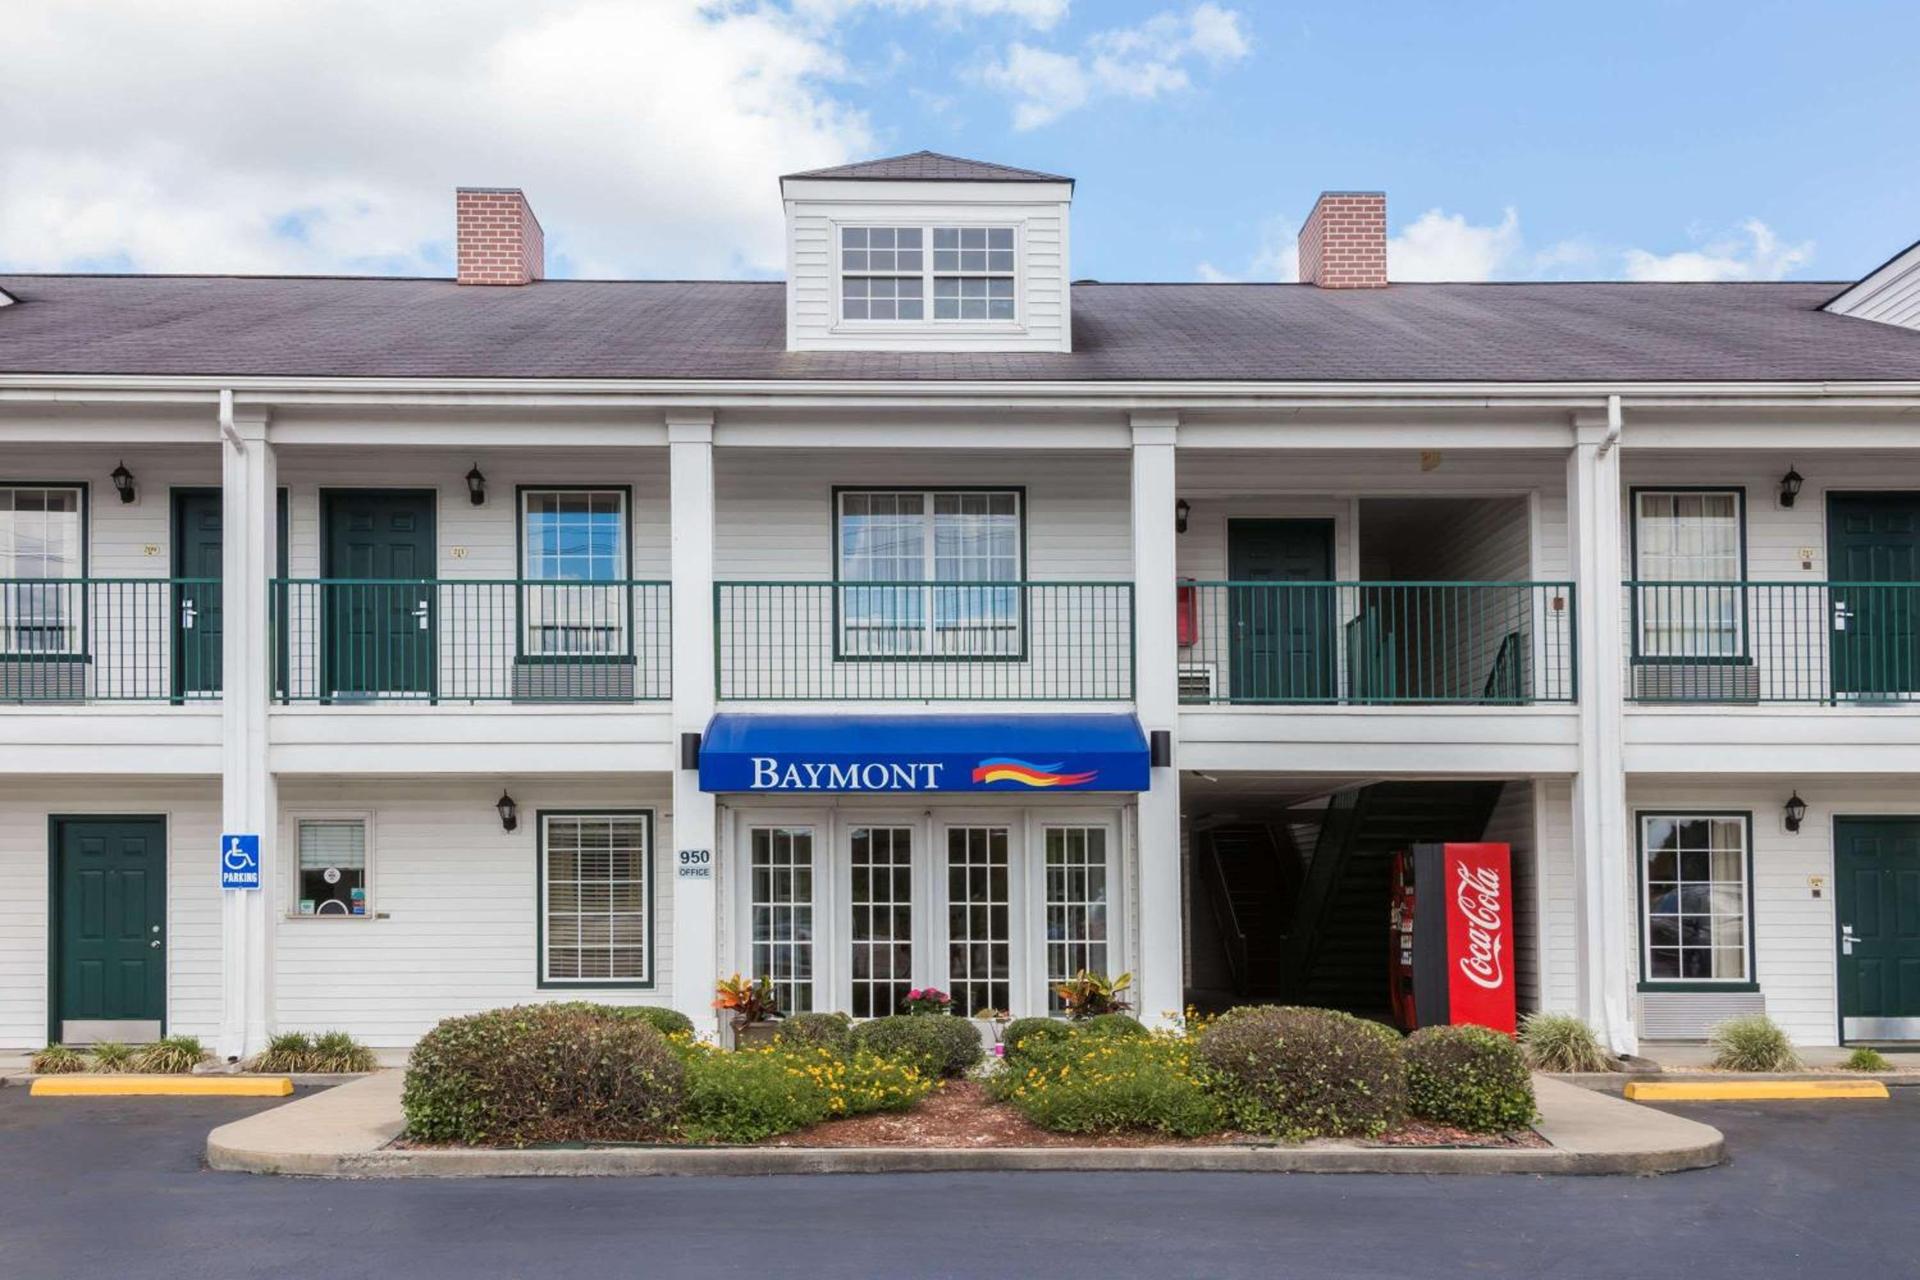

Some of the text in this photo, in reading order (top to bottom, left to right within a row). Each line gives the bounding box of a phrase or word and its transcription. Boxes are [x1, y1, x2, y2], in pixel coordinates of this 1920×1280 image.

[750, 757, 944, 789] BAYMONT
[680, 850, 710, 864] 950
[223, 872, 258, 882] PARKING
[679, 868, 710, 876] OFFICE
[1457, 860, 1504, 989] Coca-Cola
